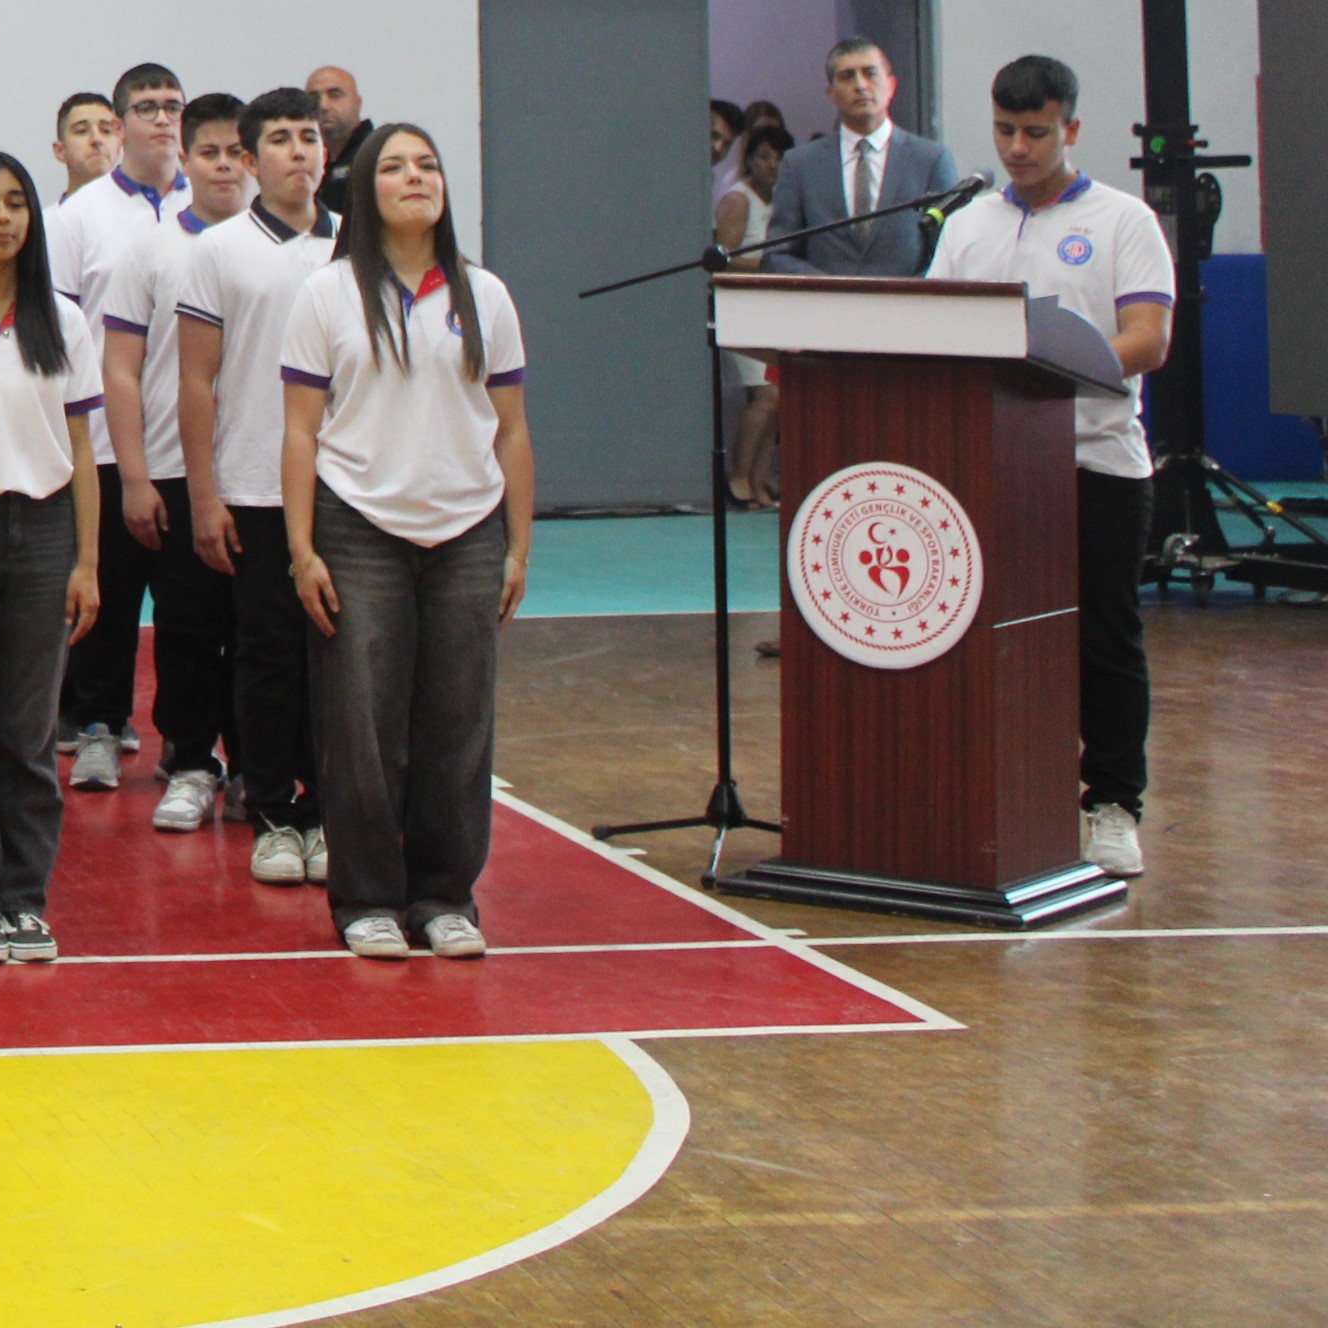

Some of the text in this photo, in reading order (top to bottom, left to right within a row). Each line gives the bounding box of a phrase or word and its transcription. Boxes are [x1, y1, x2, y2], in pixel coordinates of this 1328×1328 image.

[831, 503, 941, 616] TÜRKİYE CUMHURİYETİ GENÇLİK VE SPOR BAKANLIĞI
